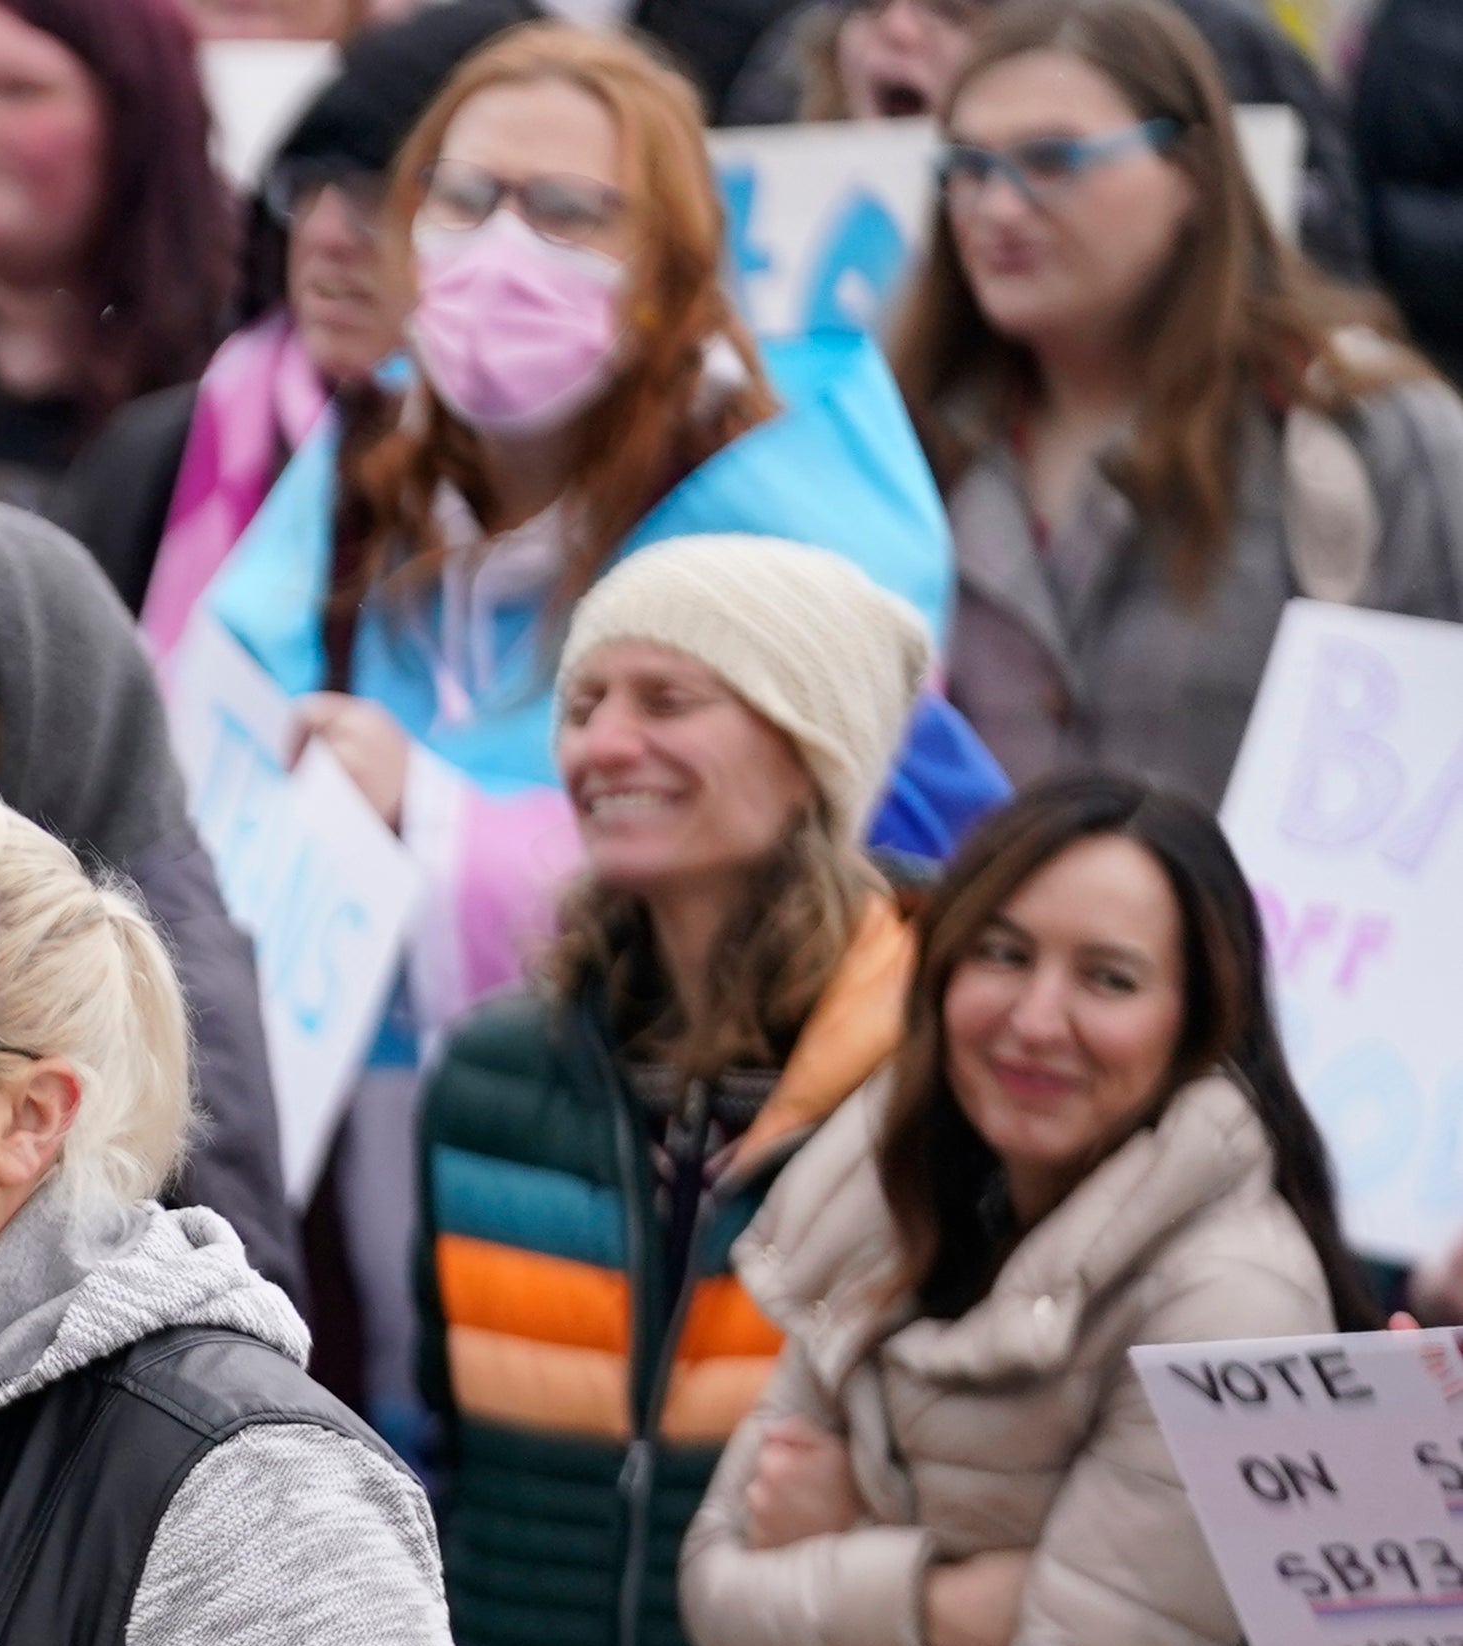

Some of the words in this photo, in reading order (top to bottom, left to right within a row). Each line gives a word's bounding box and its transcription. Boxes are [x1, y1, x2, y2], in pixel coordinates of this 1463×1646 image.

[1167, 1343, 1377, 1406] VOTE
[1237, 1447, 1341, 1504] ON
[1414, 1436, 1463, 1494] S
[1275, 1536, 1463, 1600] SB93
